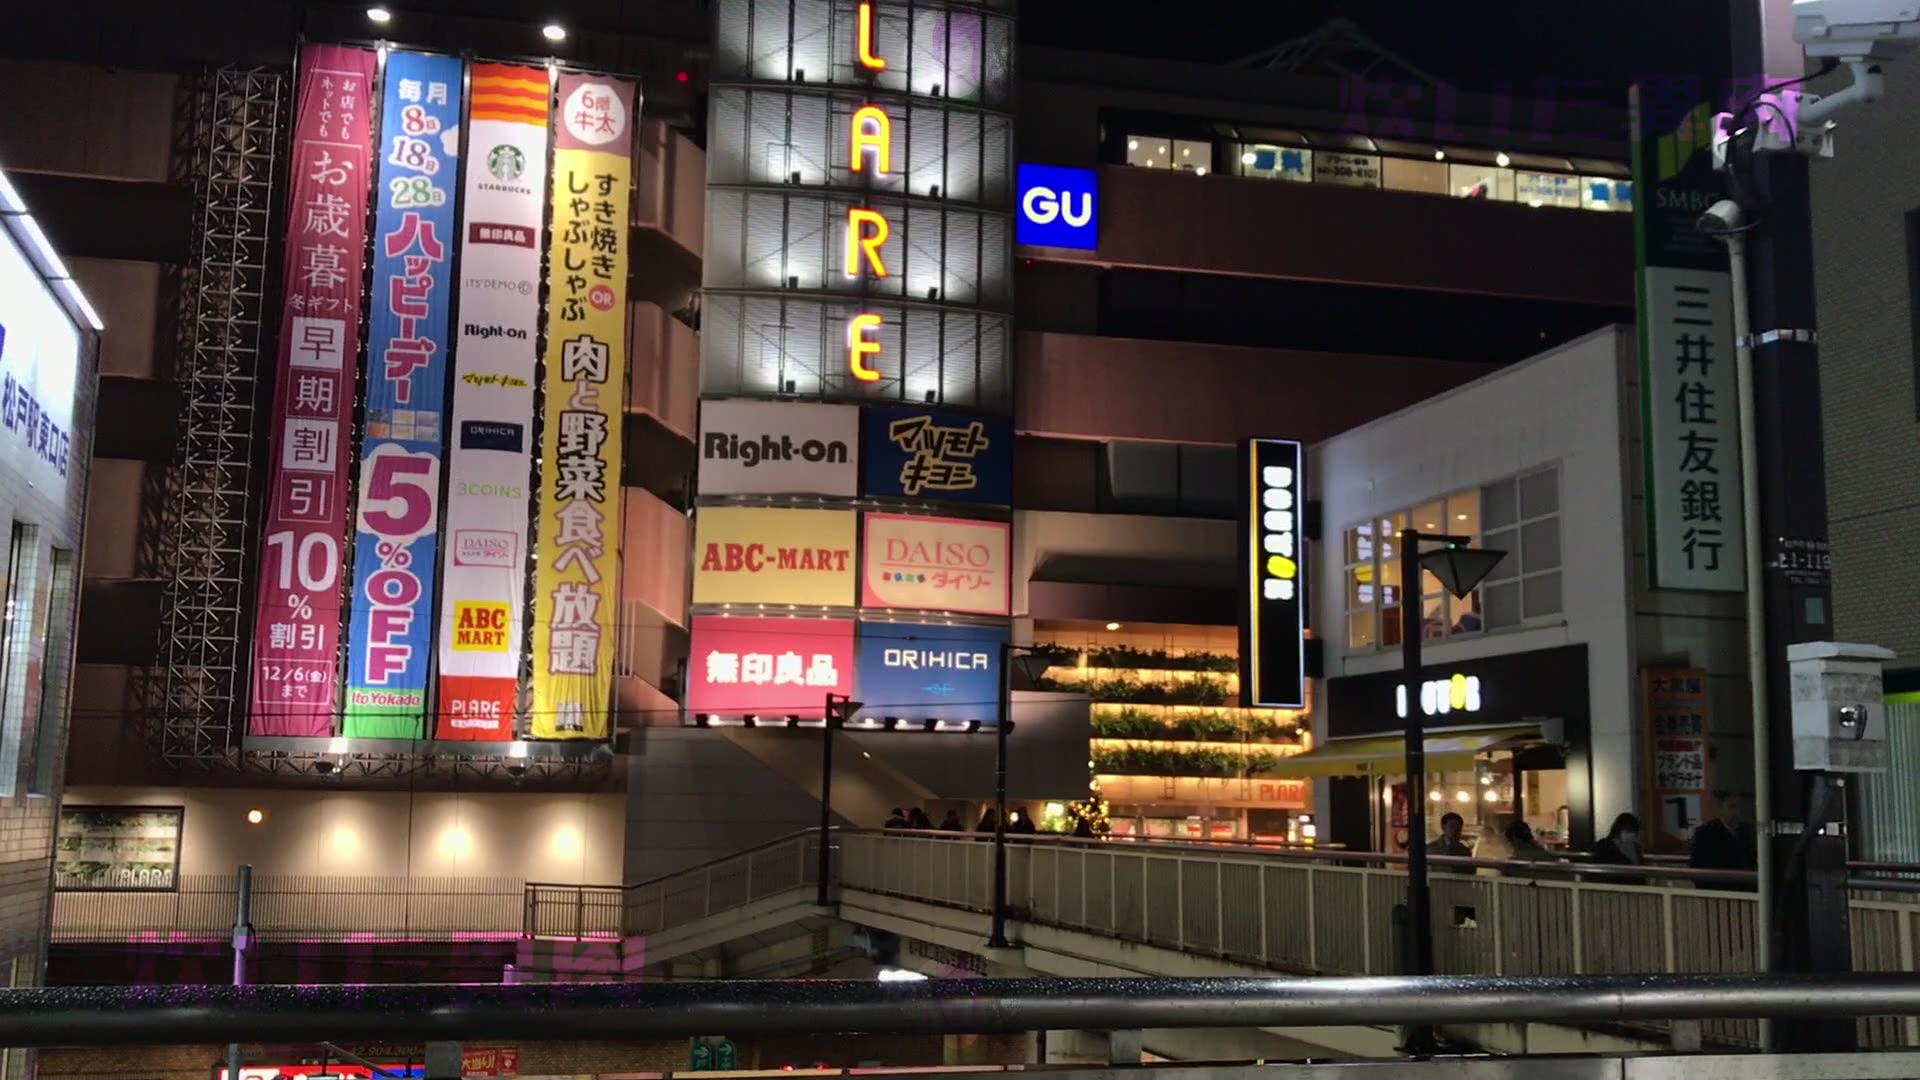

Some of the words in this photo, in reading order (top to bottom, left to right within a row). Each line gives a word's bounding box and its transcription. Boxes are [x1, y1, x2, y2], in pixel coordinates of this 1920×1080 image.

[399, 79, 448, 105] 毎月
[319, 76, 337, 139] ネットでも
[341, 79, 356, 140] お店でも
[403, 107, 438, 134] 8日
[575, 112, 616, 135] 牛太
[391, 177, 444, 206] 28日
[478, 182, 531, 196] STARBUCKS
[302, 151, 355, 290] お歳暮
[1023, 186, 1092, 228] GU
[479, 227, 527, 244] 無印良品
[590, 173, 619, 281] すき焼き
[560, 170, 591, 323] しゃぶしゃぶ
[288, 293, 353, 311] 冬ギフト
[384, 211, 443, 404] ハッピーデー
[592, 291, 613, 306] OR
[464, 322, 528, 340] Right-on
[2, 371, 70, 478] 松戸駅東口店
[290, 326, 336, 517] 早期割引
[1673, 285, 1724, 573] 三井住友銀行
[704, 432, 849, 467] Right-on
[890, 415, 989, 459] マツモト
[899, 455, 977, 495] キヨシ
[457, 482, 521, 500] 3COINS
[550, 334, 608, 676] 肉と野菜食べ放題
[463, 537, 510, 550] DAISO
[700, 542, 849, 573] ABC-MART
[885, 536, 990, 569] DAISO
[930, 570, 992, 591] ダイソー
[458, 606, 506, 631] ABC
[269, 622, 324, 651] 割引
[457, 629, 505, 647] MART
[706, 649, 839, 687] 無印良品
[884, 648, 989, 672] ORIHICA
[280, 683, 309, 700] まで
[451, 699, 501, 718] PLARE
